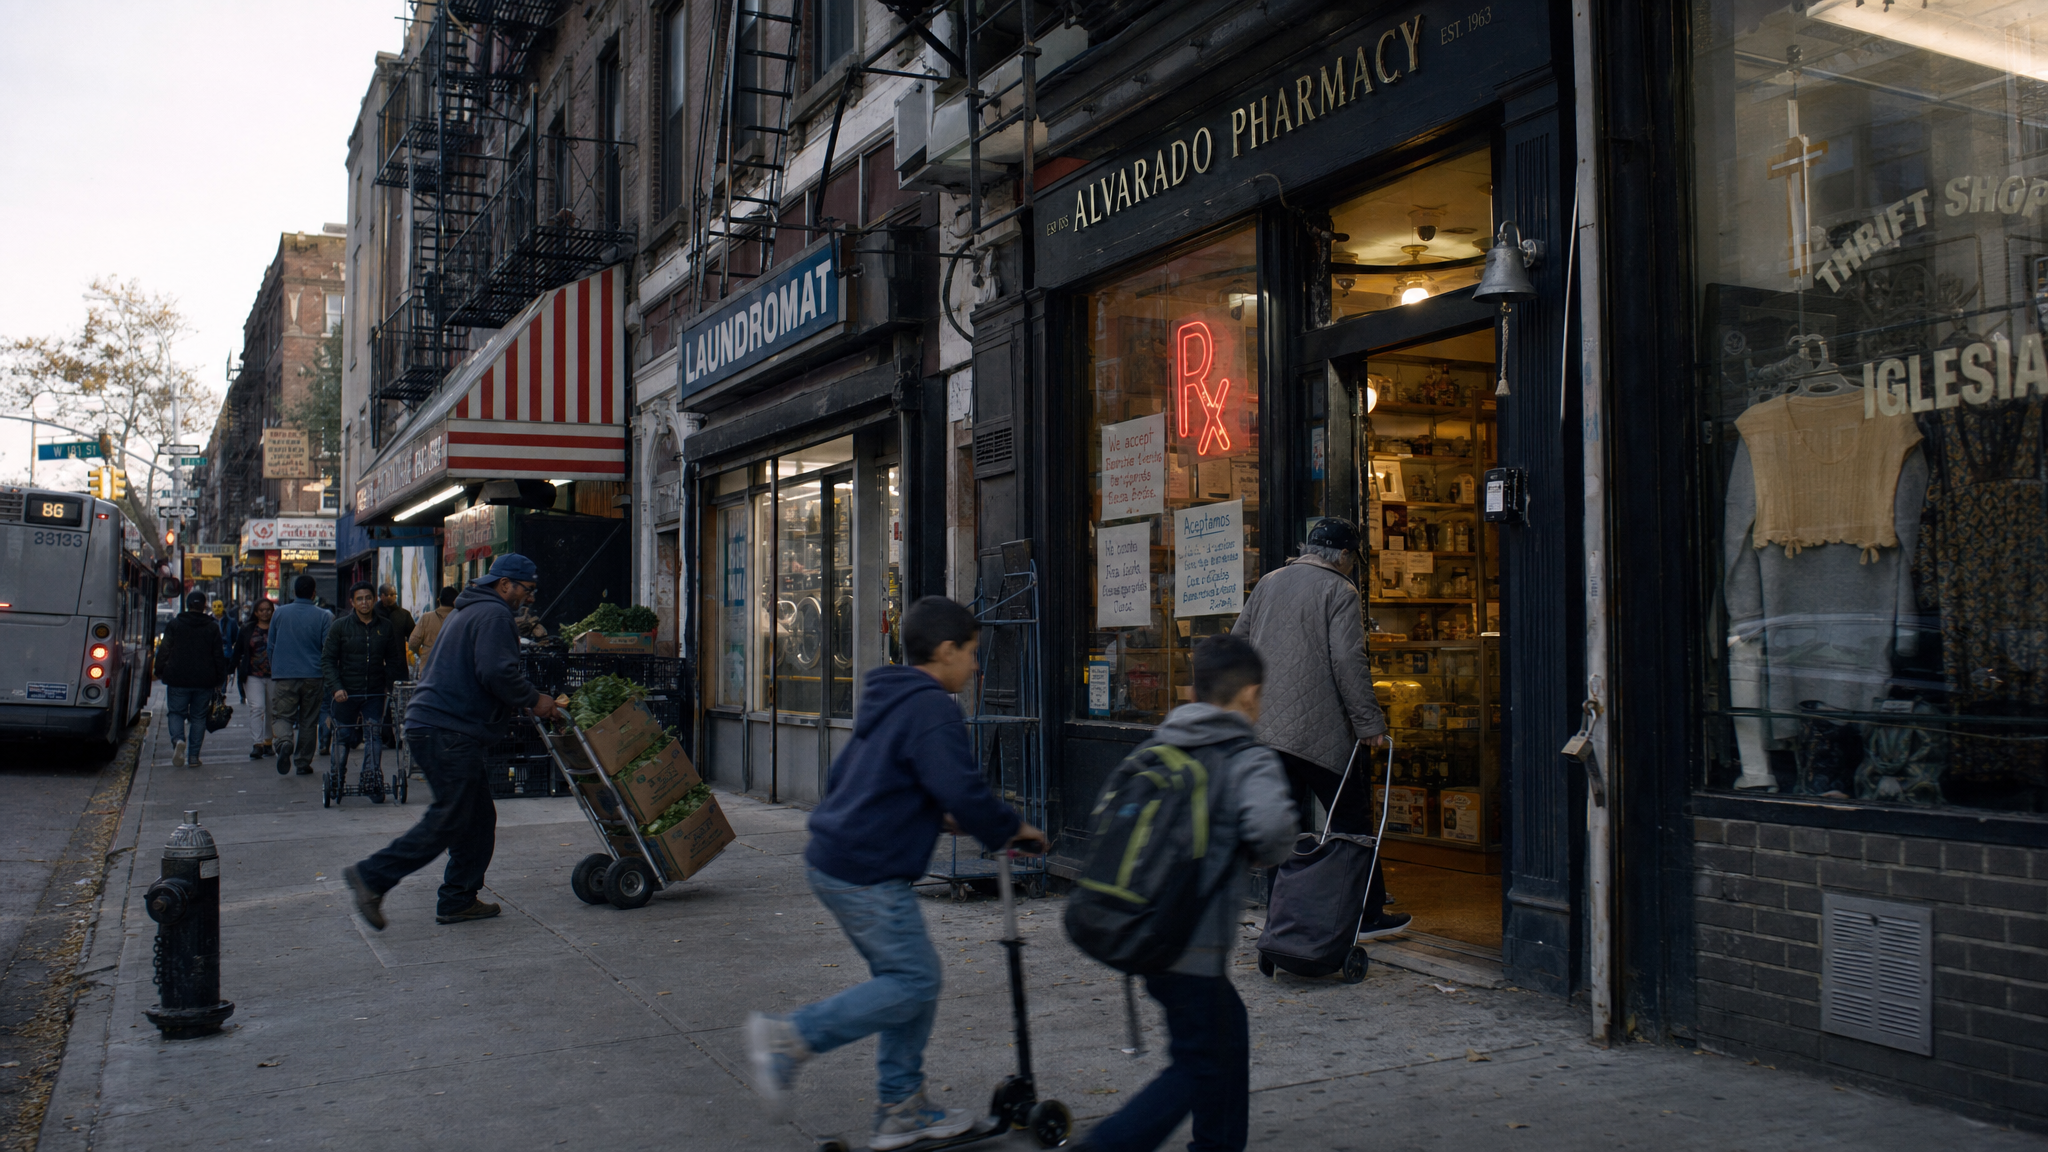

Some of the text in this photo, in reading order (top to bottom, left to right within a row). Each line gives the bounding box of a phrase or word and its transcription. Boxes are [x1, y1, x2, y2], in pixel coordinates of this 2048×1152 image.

[1440, 5, 1492, 46] EST. 1963
[1073, 13, 1424, 232] ALVARADO PHARMACY
[1815, 174, 2048, 294] THRIFT SHOP
[685, 258, 832, 385] LAUNDROMAT
[1863, 332, 2048, 420] IGLESIA
[53, 446, 63, 458] W
[1108, 426, 1154, 452] We accept
[42, 502, 64, 518] 86
[1183, 512, 1230, 538] Aceptamos
